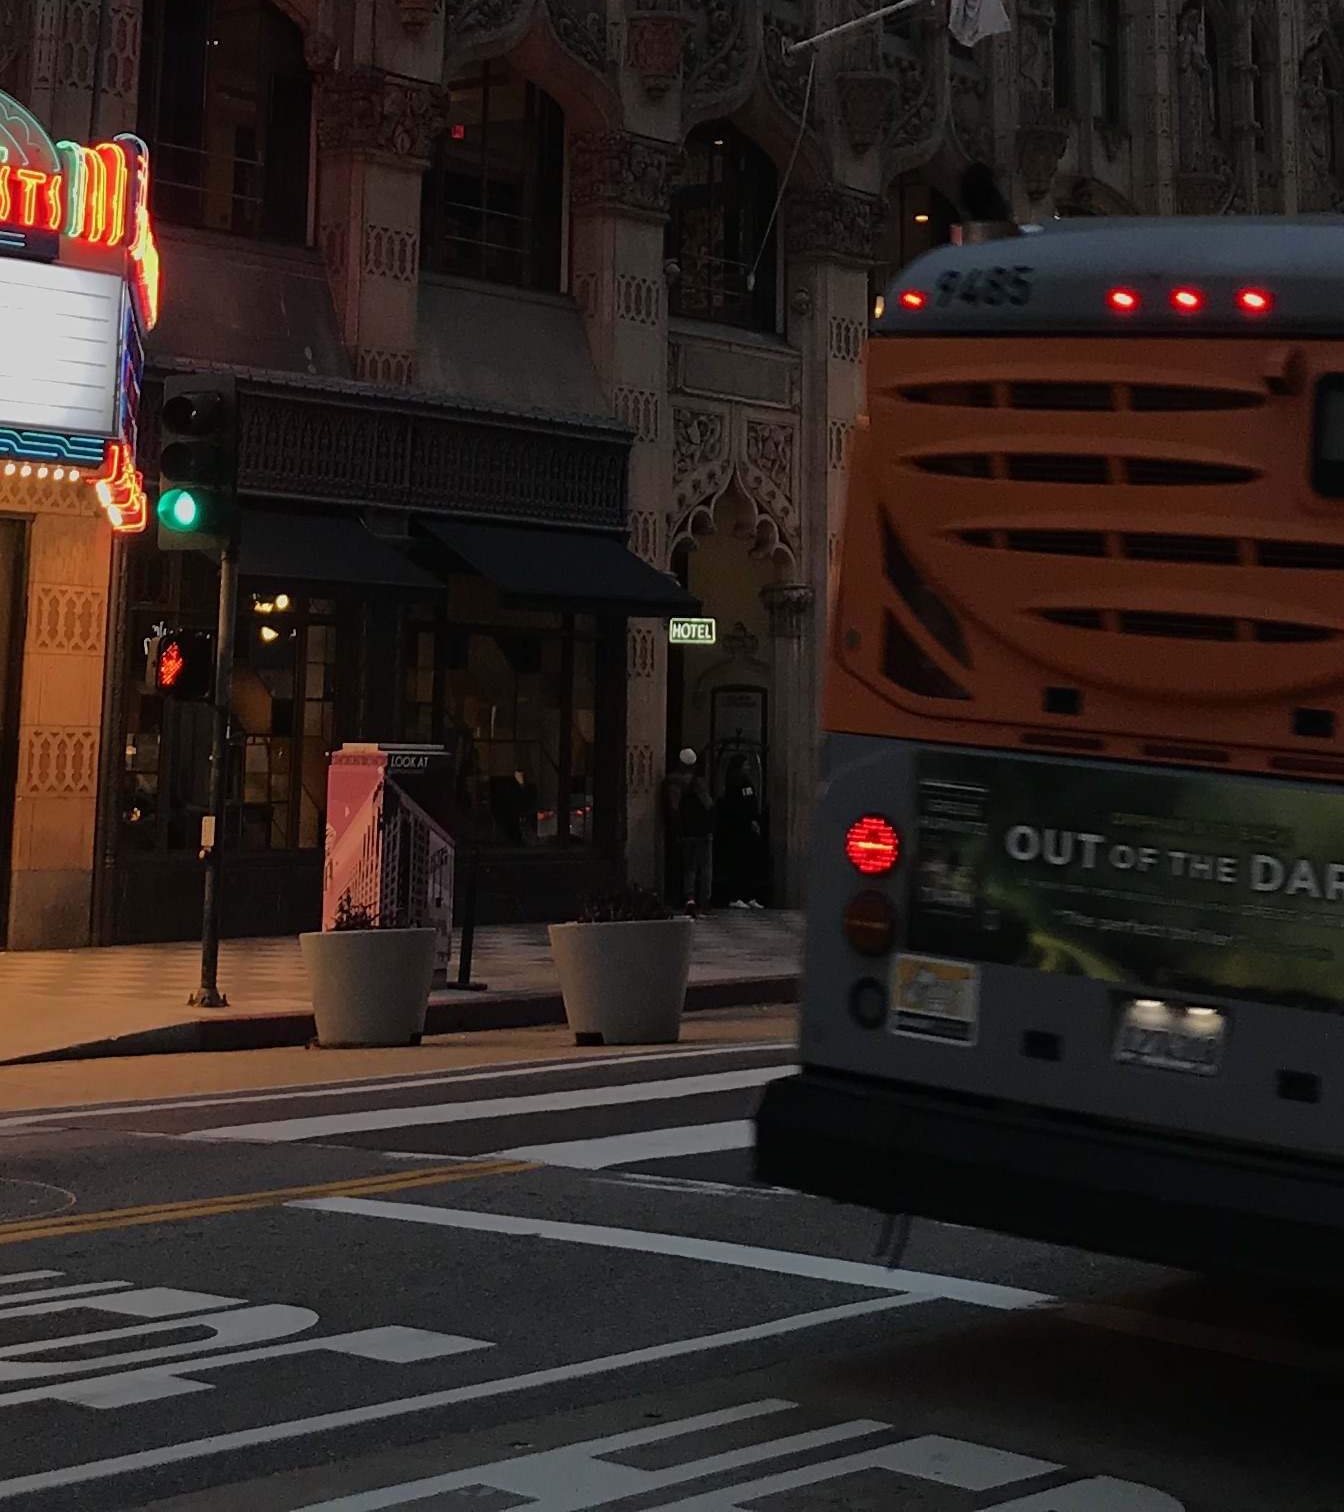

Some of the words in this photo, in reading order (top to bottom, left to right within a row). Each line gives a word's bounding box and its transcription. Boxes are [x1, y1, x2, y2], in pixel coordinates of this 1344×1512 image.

[672, 623, 712, 638] HOTEL
[390, 755, 416, 768] LOOK
[417, 756, 430, 768] AT
[1005, 824, 1106, 869] OUT
[1108, 844, 1160, 872] OF
[1167, 850, 1238, 884] THE
